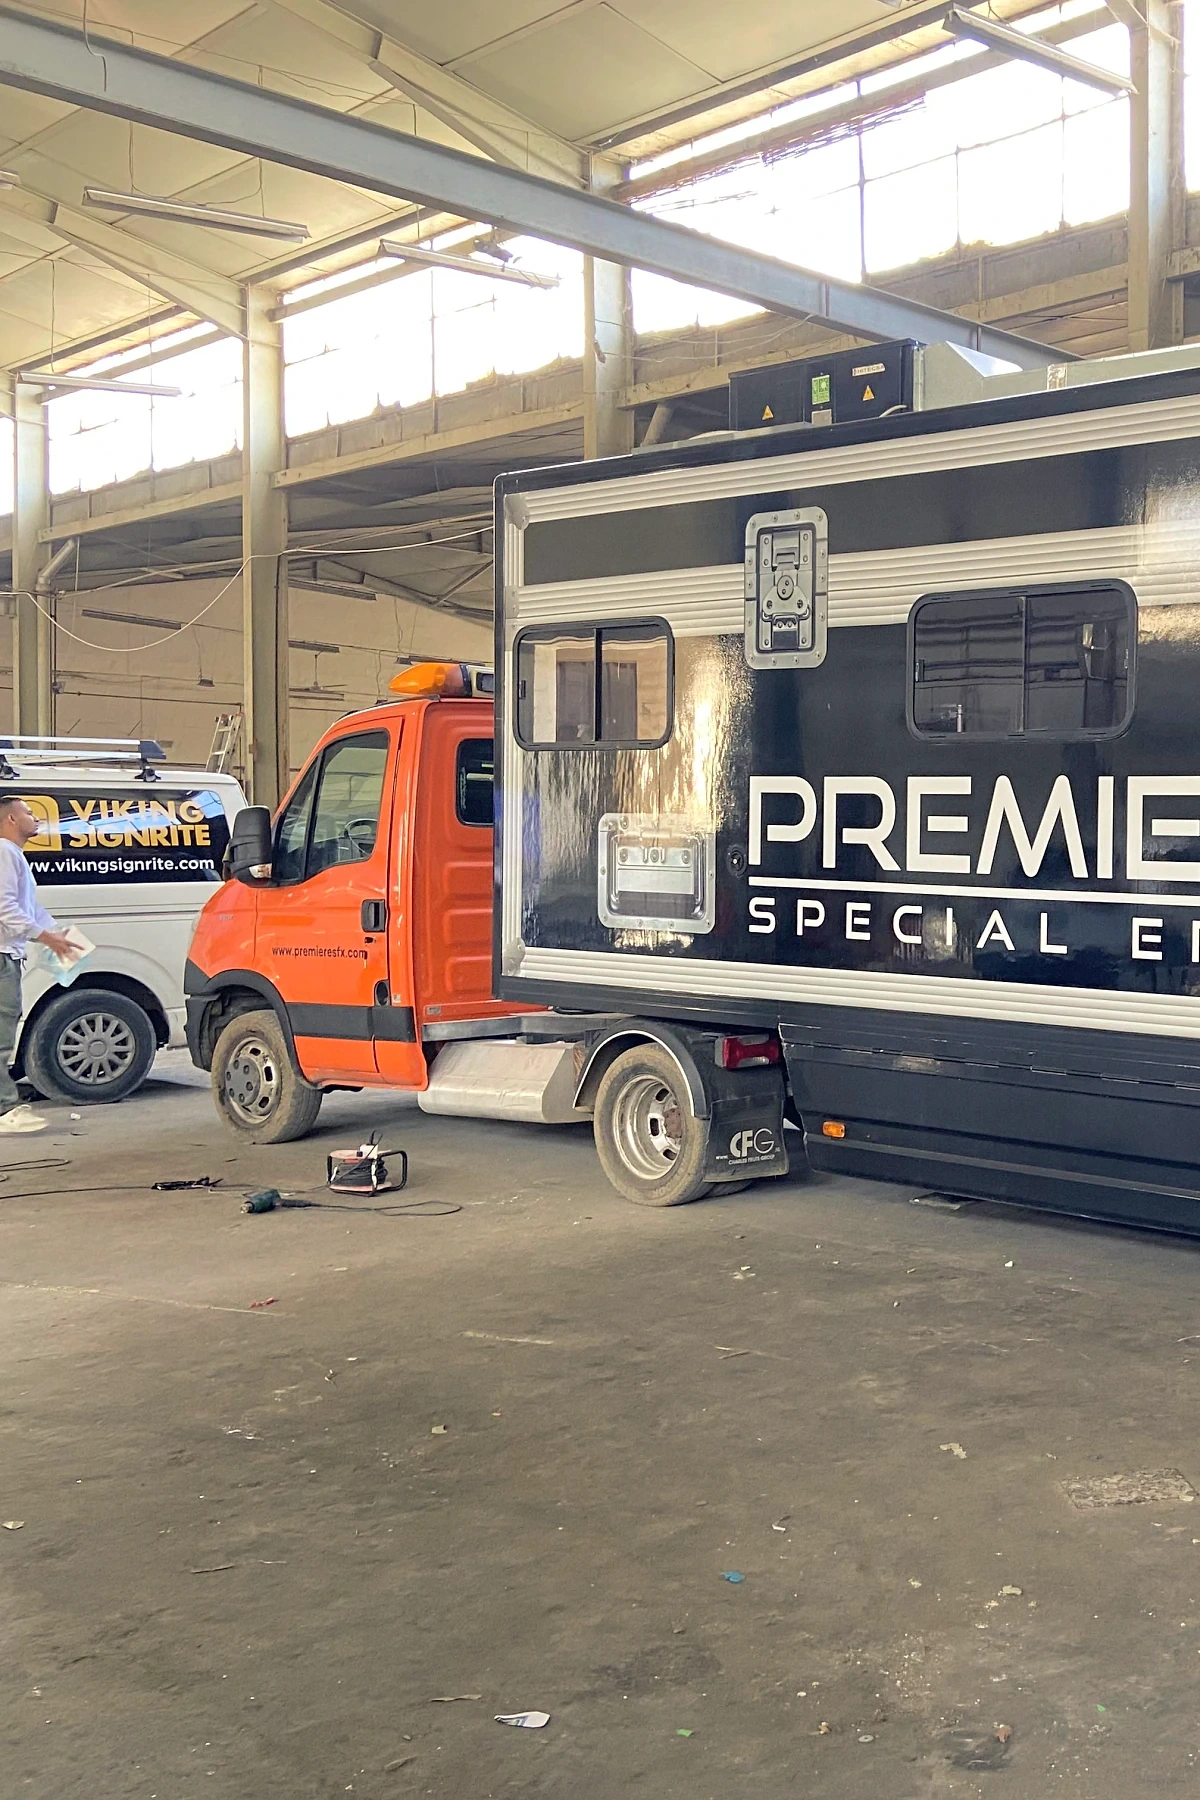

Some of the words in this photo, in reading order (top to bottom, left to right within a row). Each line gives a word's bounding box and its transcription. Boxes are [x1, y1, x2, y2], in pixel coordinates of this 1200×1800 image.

[68, 799, 205, 824] VIKING
[68, 824, 211, 848] SIGNRITE
[29, 857, 215, 874] w.vikingsignrite.com
[748, 896, 1068, 955] SPECIAL
[271, 945, 367, 957] www.premieresfx.com
[730, 1128, 775, 1157] CFG
